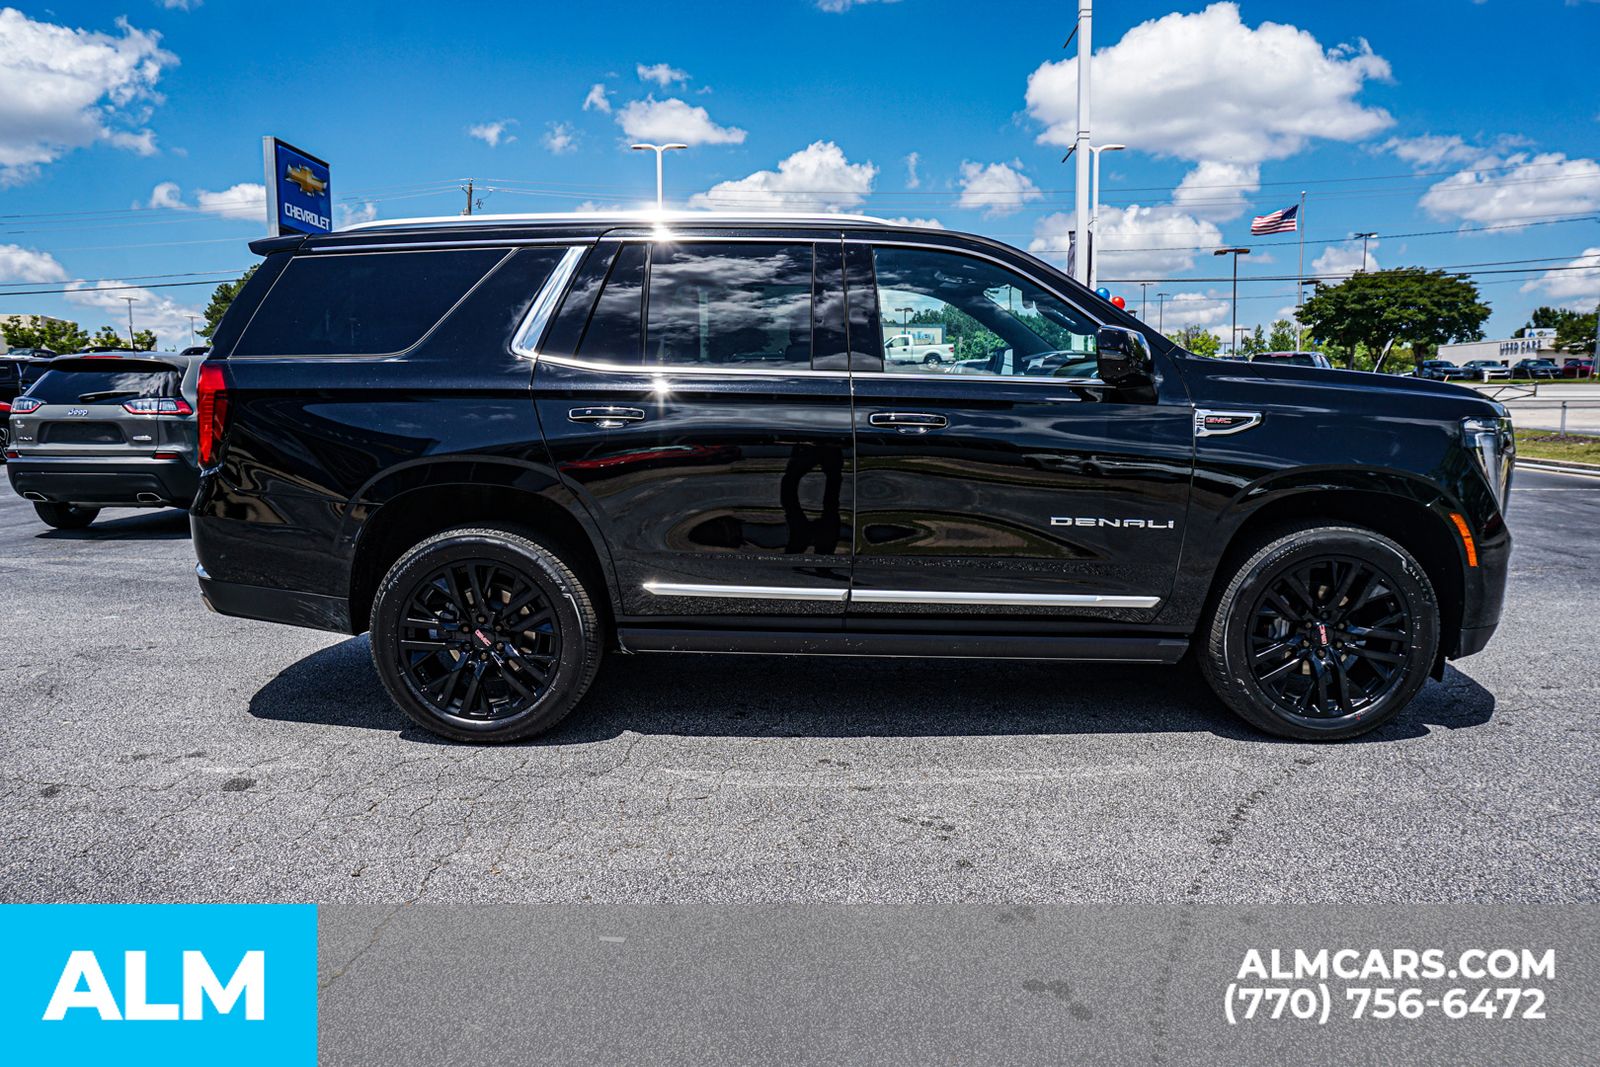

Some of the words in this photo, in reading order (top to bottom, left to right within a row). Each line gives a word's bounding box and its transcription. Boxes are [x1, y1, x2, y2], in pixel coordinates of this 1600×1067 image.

[285, 202, 330, 230] CHEVROLET
[68, 408, 88, 416] Jeep
[1206, 416, 1232, 424] GMC
[1050, 517, 1174, 529] DENALI
[475, 629, 491, 647] GMC
